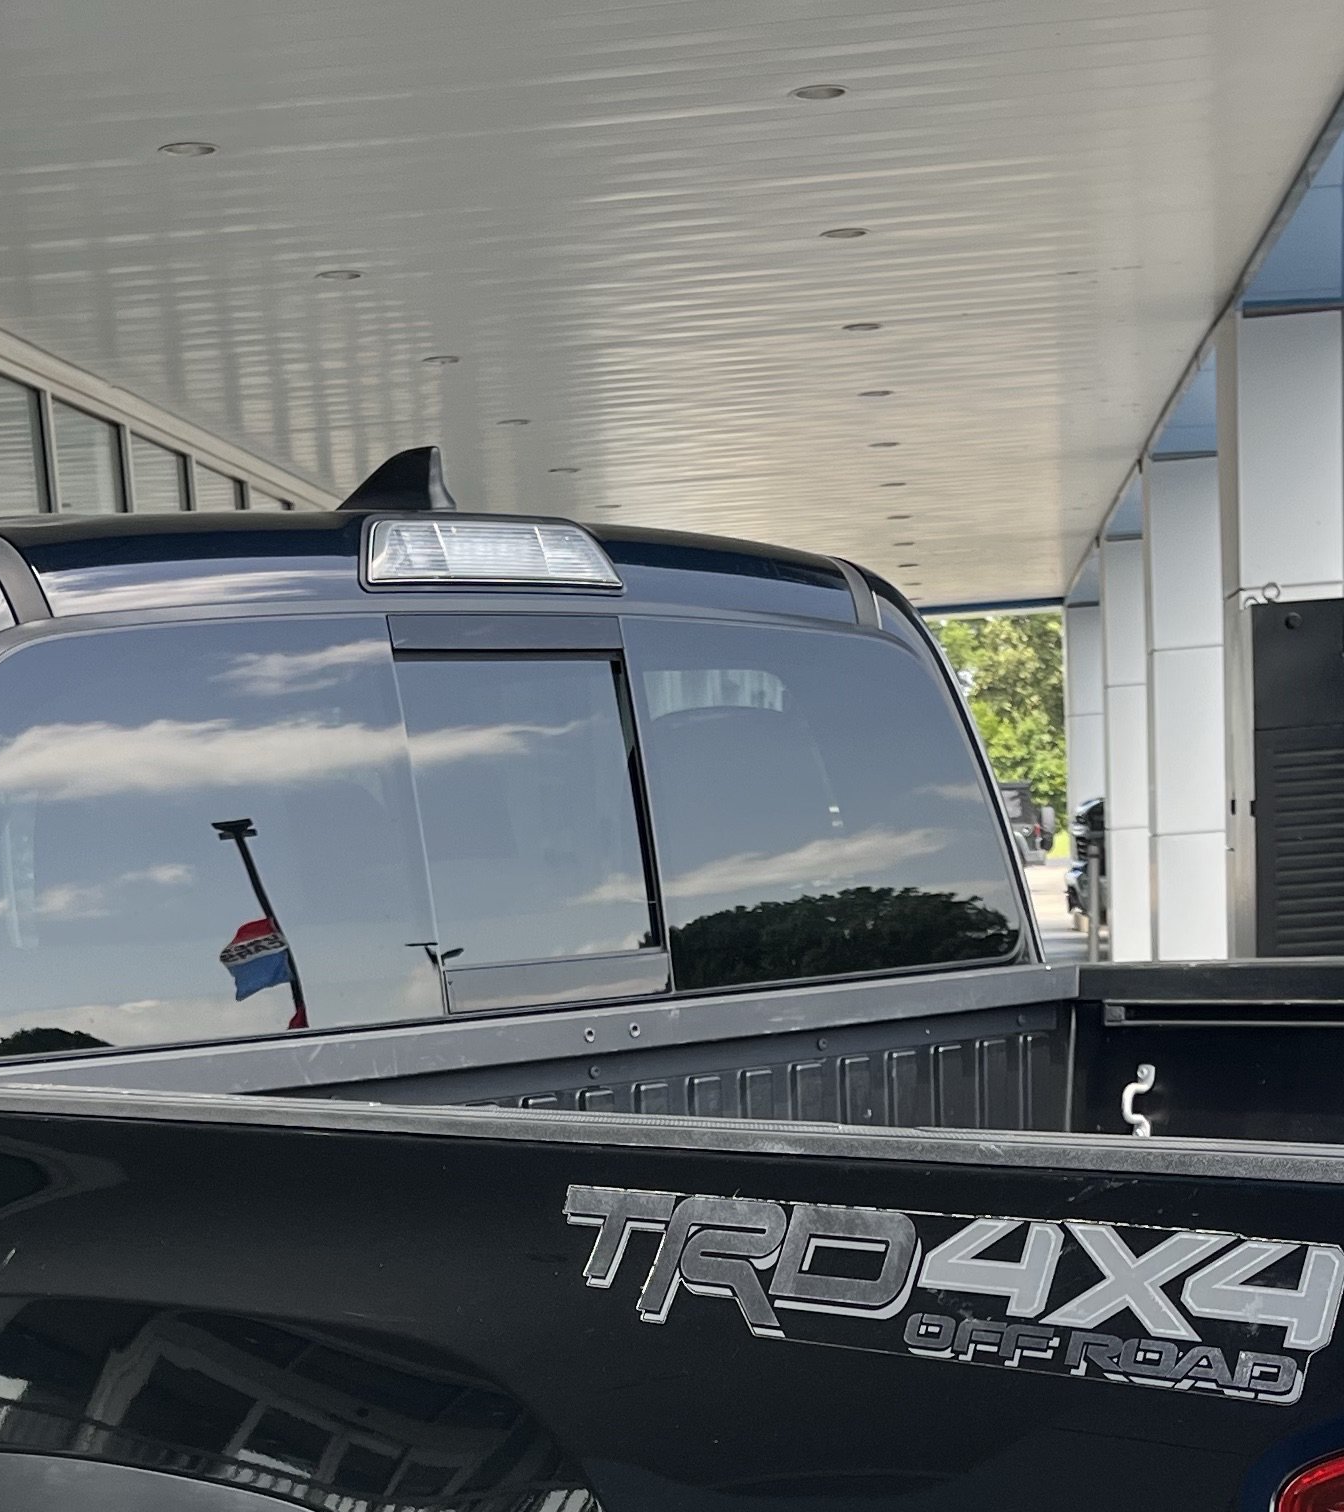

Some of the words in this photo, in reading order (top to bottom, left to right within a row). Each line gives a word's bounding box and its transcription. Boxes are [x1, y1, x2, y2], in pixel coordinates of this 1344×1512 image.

[562, 1184, 920, 1338] TRD
[902, 1312, 1058, 1368] OFF
[1063, 1328, 1305, 1403] ROAD
